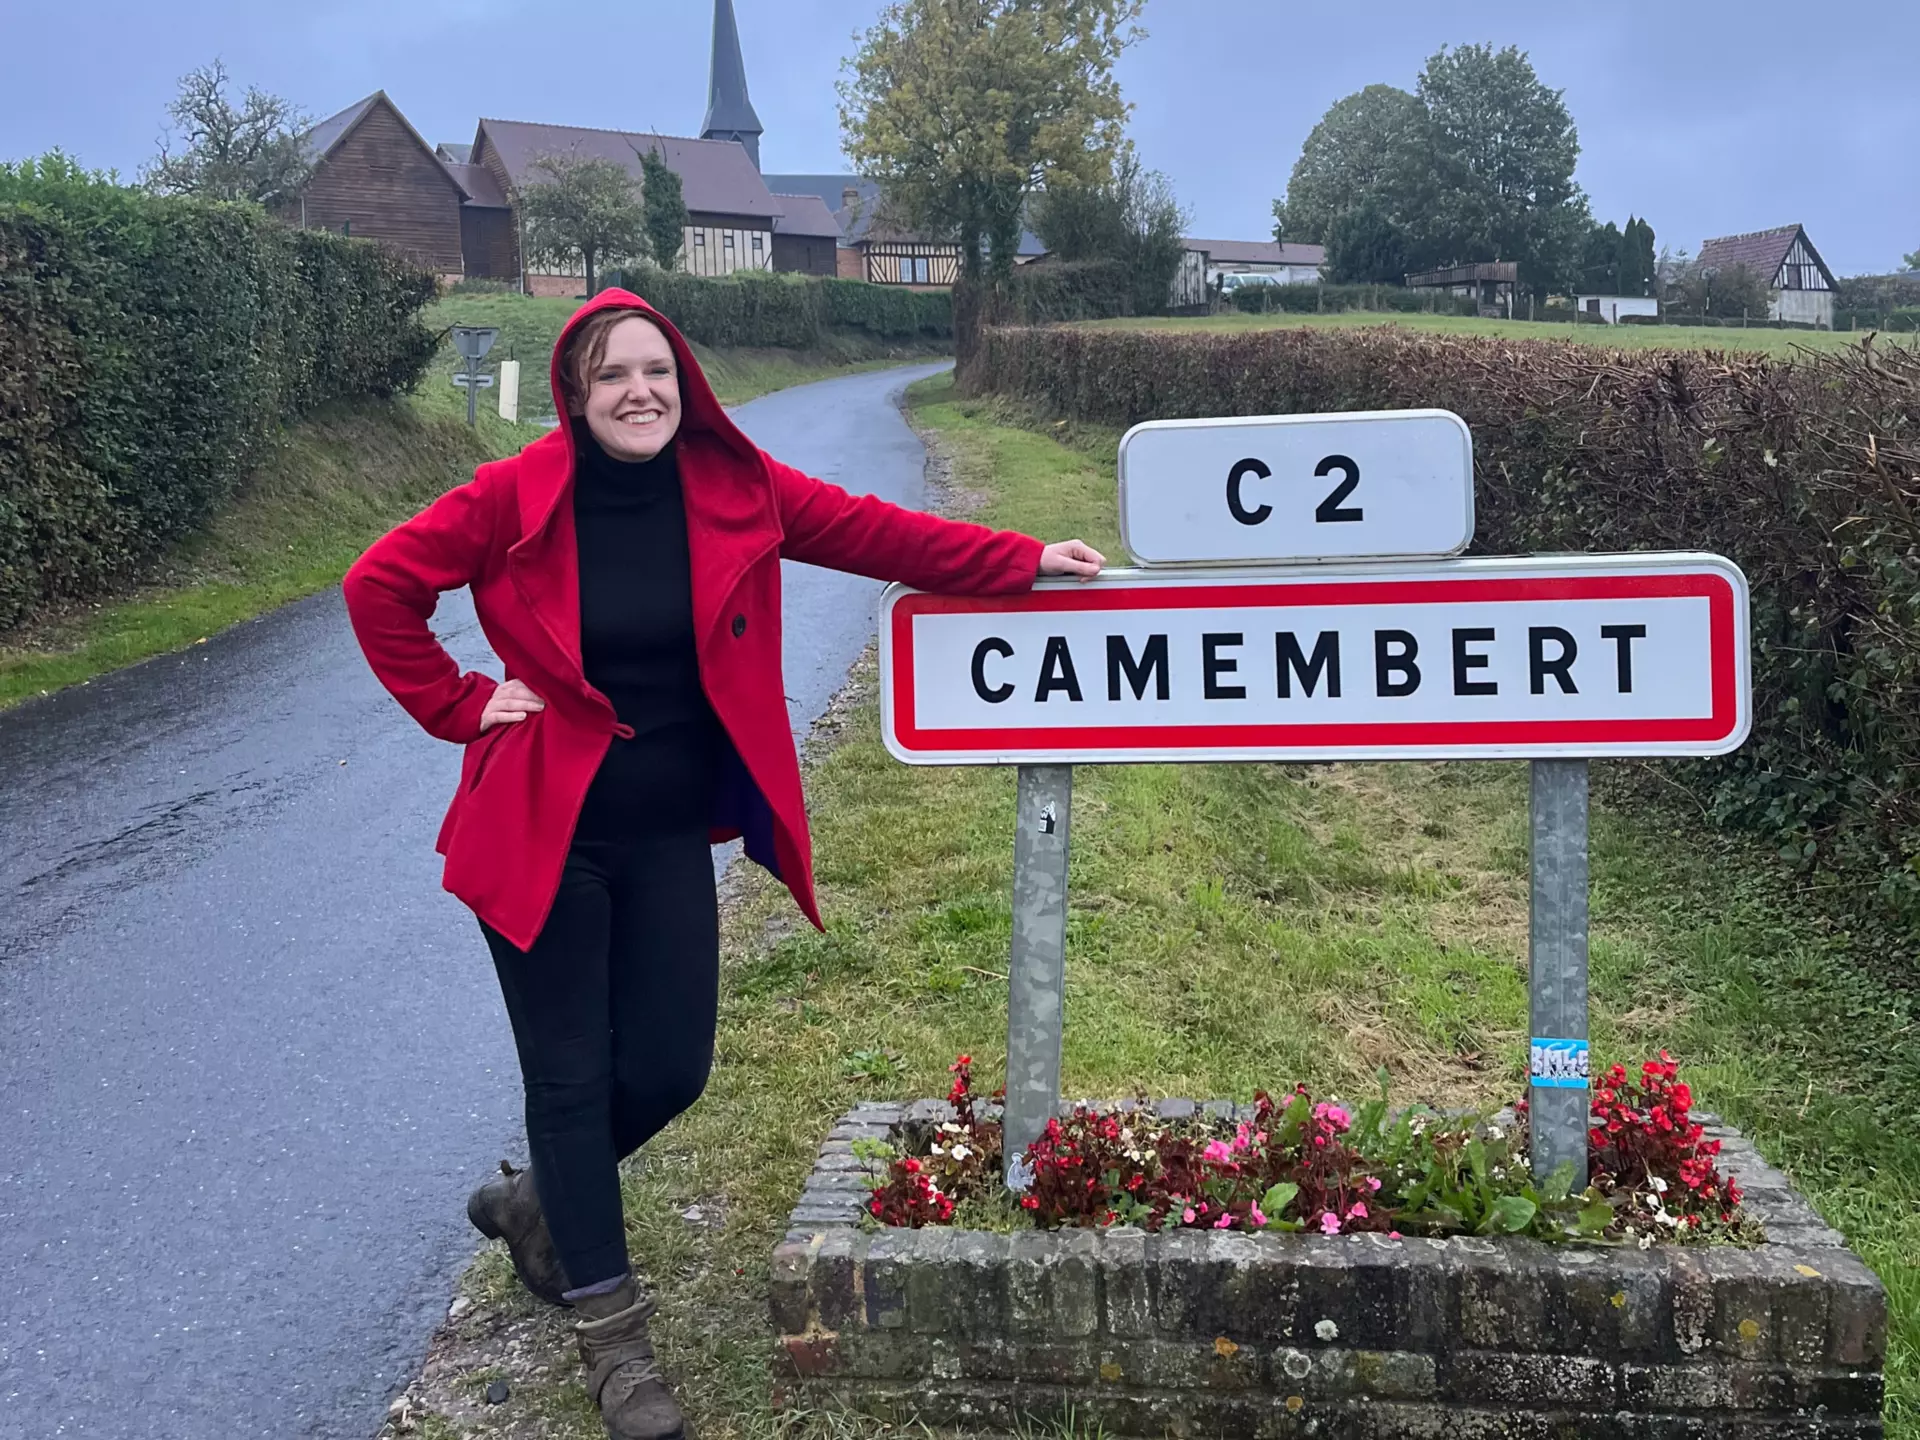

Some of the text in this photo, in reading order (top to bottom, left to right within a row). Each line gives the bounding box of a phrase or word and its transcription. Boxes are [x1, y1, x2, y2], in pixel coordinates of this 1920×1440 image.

[1226, 454, 1364, 526] C 2
[970, 624, 1647, 704] CAMEMBERT
